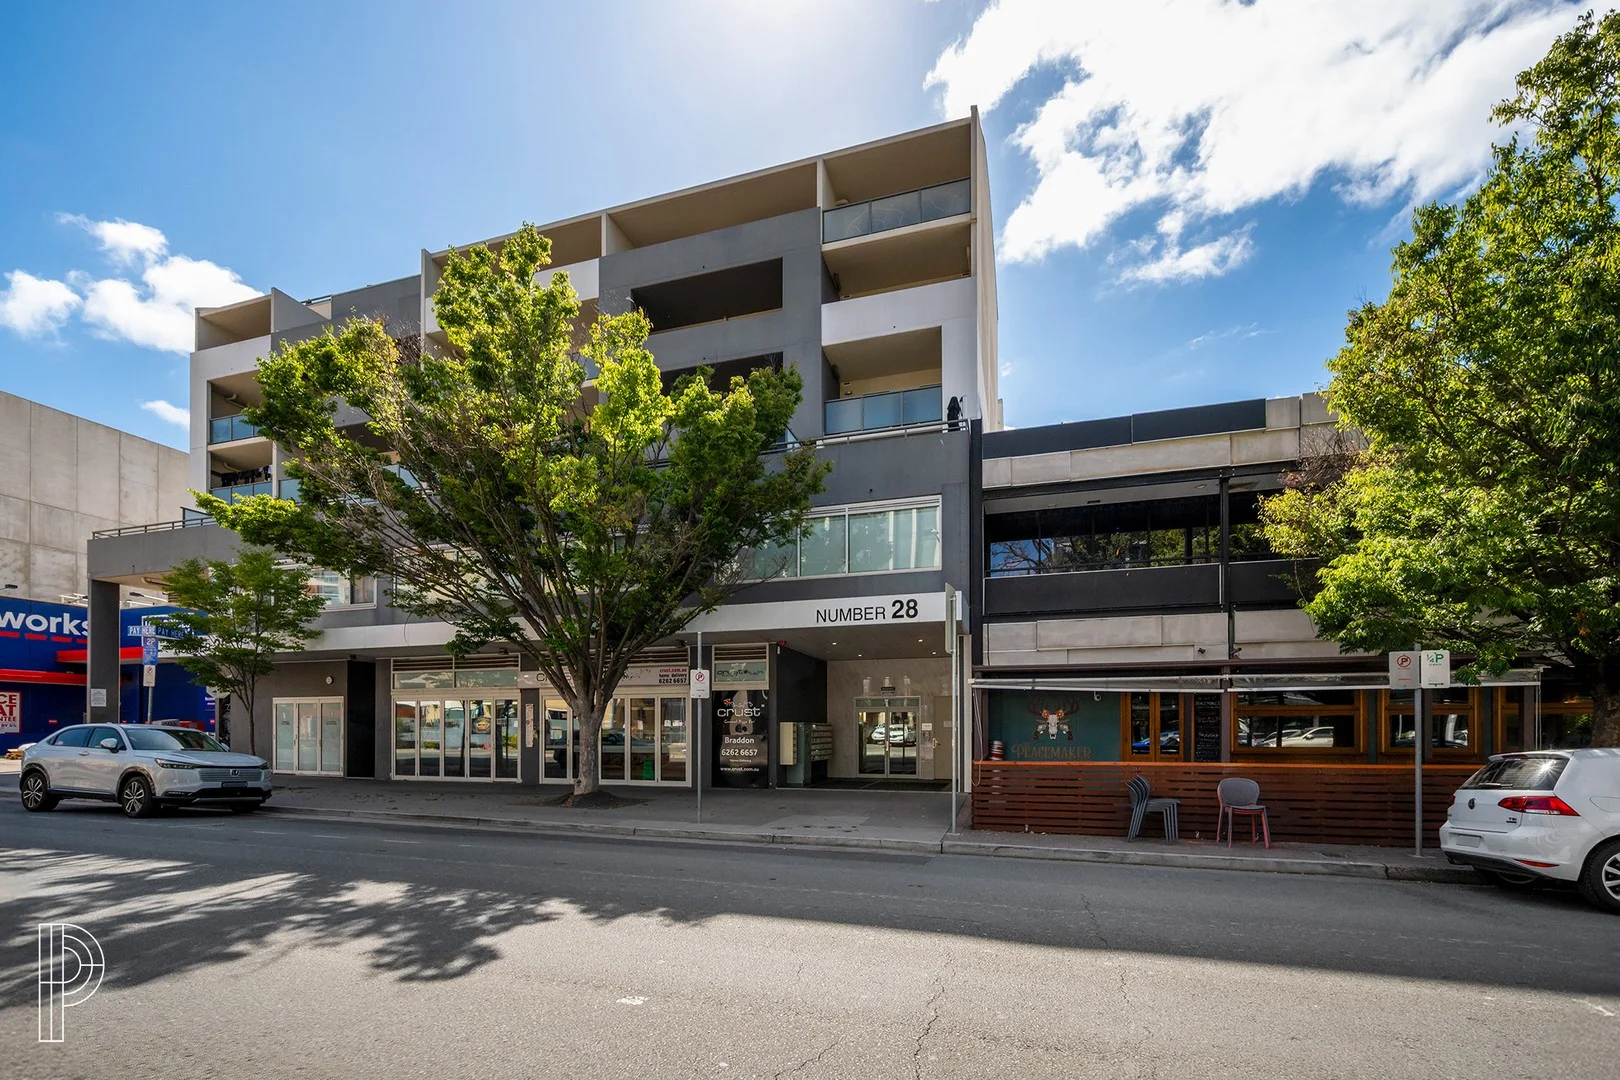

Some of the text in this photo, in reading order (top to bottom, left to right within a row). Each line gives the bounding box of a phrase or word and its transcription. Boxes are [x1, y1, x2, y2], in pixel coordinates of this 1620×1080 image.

[816, 598, 919, 624] NUMBER 28
[129, 626, 156, 635] PAY HERE
[157, 627, 185, 639] PAY HERE
[146, 638, 156, 646] 2P
[717, 706, 761, 717] crust
[724, 736, 755, 744] Braddon
[721, 748, 758, 756] 6262 6657
